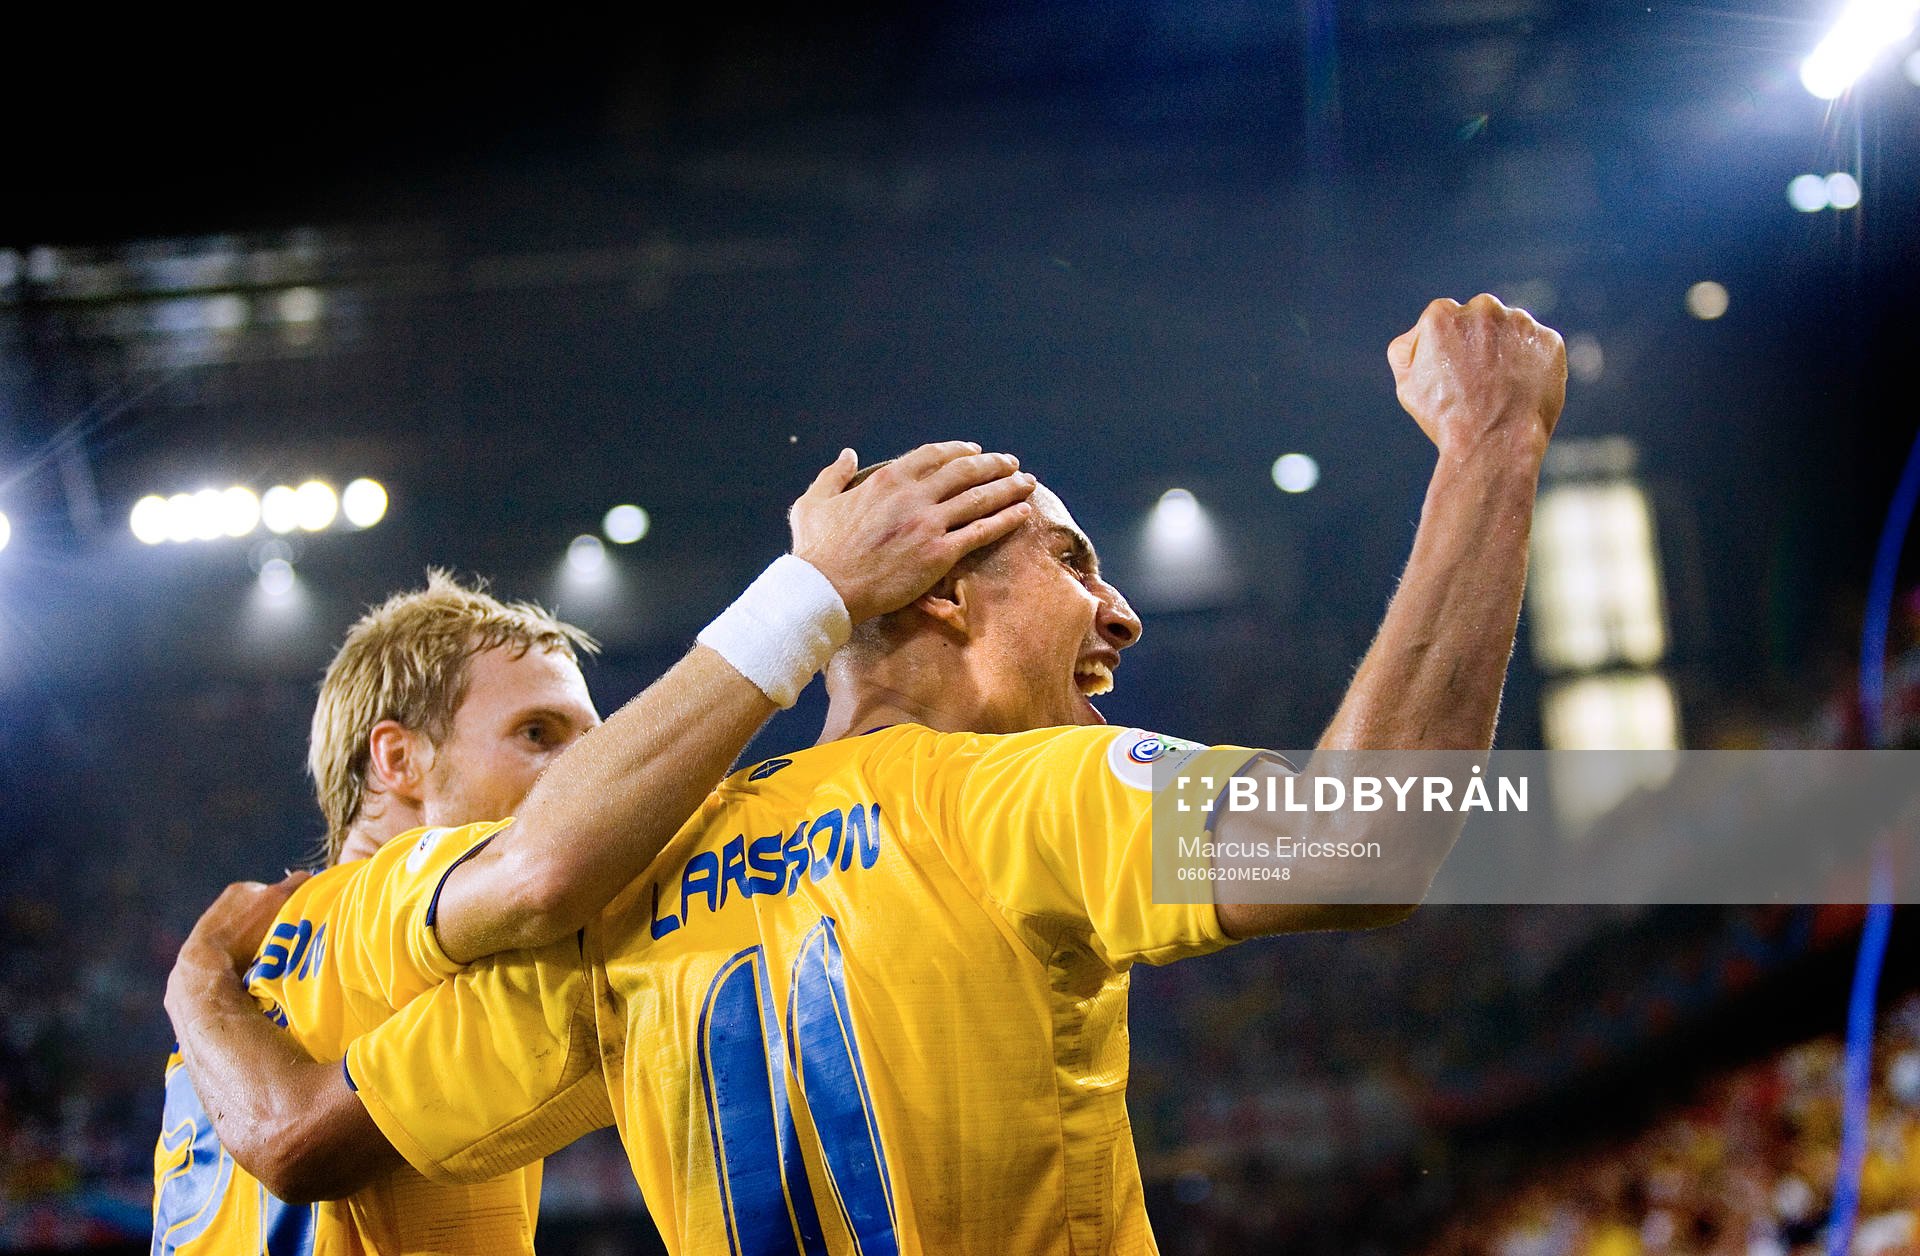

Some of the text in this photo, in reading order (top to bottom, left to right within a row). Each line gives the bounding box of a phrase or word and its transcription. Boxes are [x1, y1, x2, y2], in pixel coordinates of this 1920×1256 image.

[650, 803, 881, 941] LARSSON
[242, 919, 327, 989] SON
[697, 915, 901, 1256] 11
